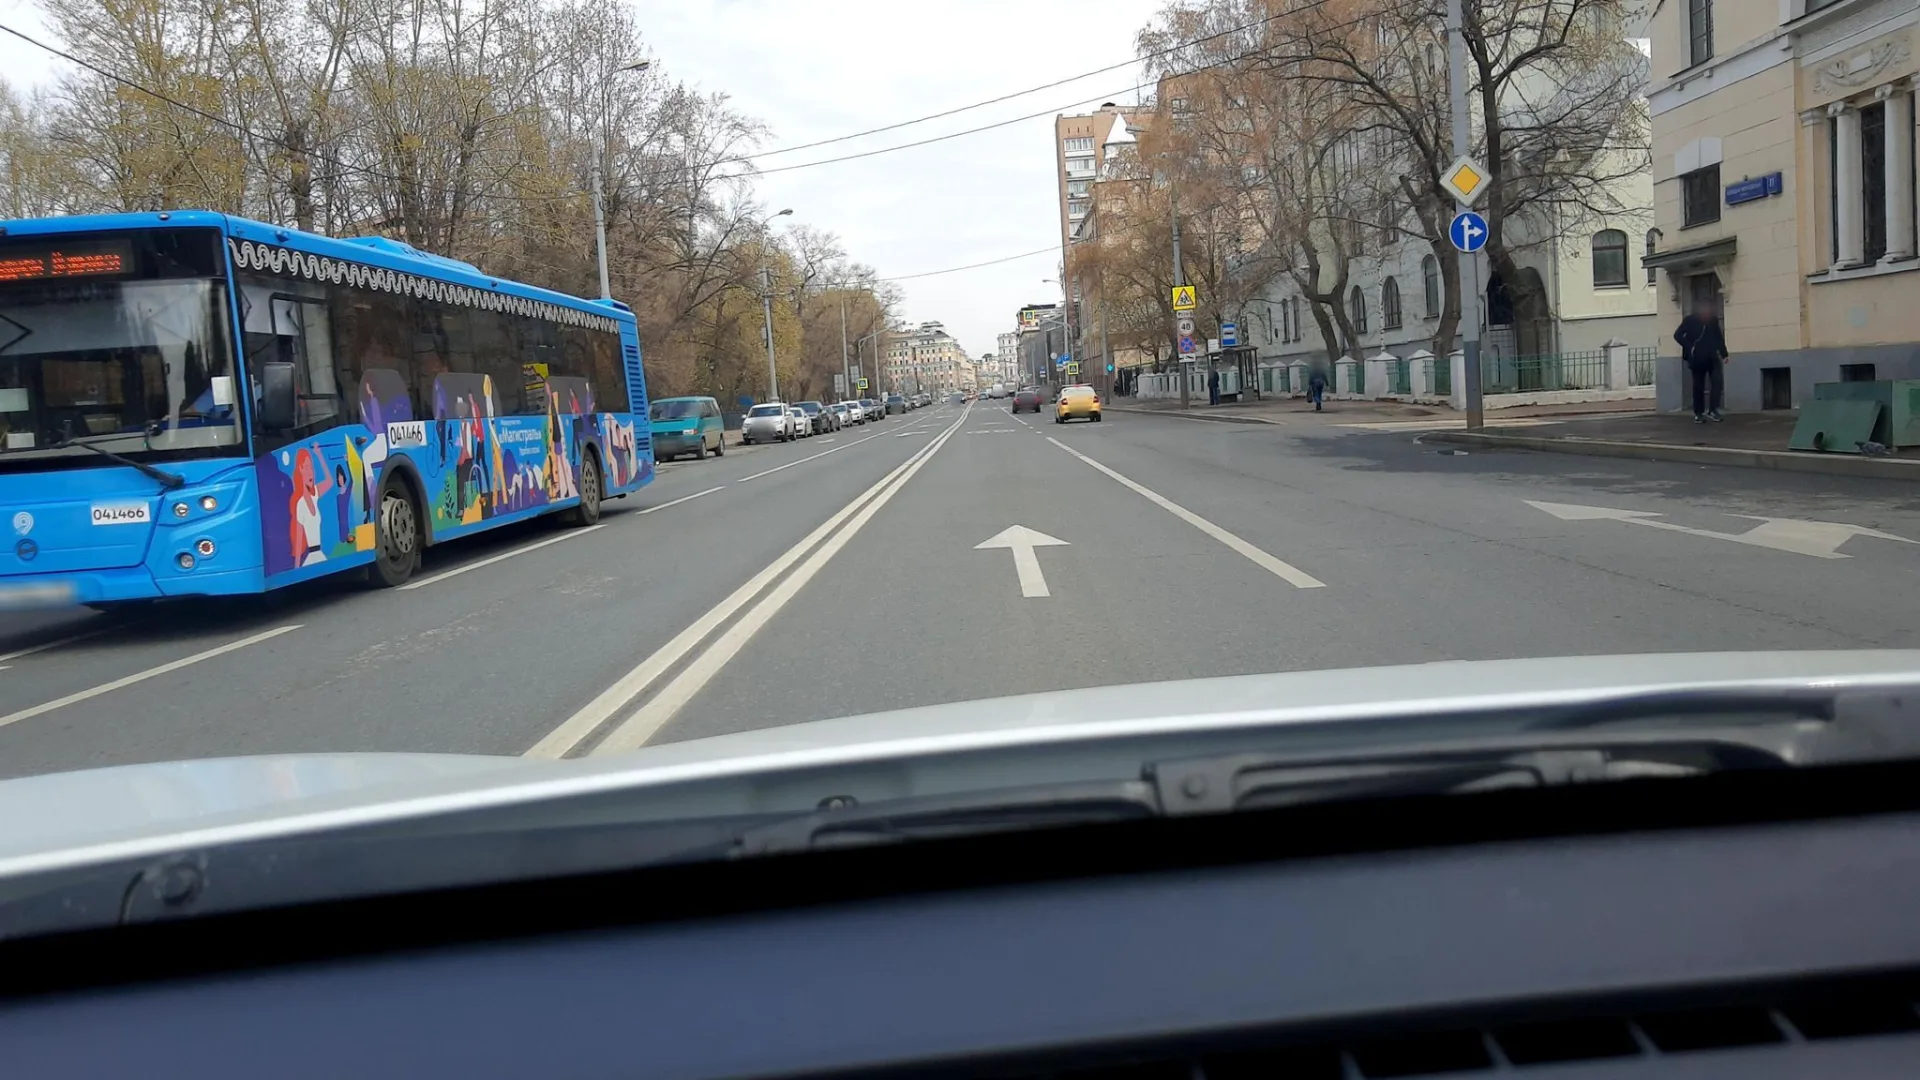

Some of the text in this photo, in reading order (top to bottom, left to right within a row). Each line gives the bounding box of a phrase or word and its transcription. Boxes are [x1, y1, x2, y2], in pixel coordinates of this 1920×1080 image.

[1181, 323, 1191, 331] 40
[390, 424, 423, 445] 041466
[93, 508, 145, 521] 041466
